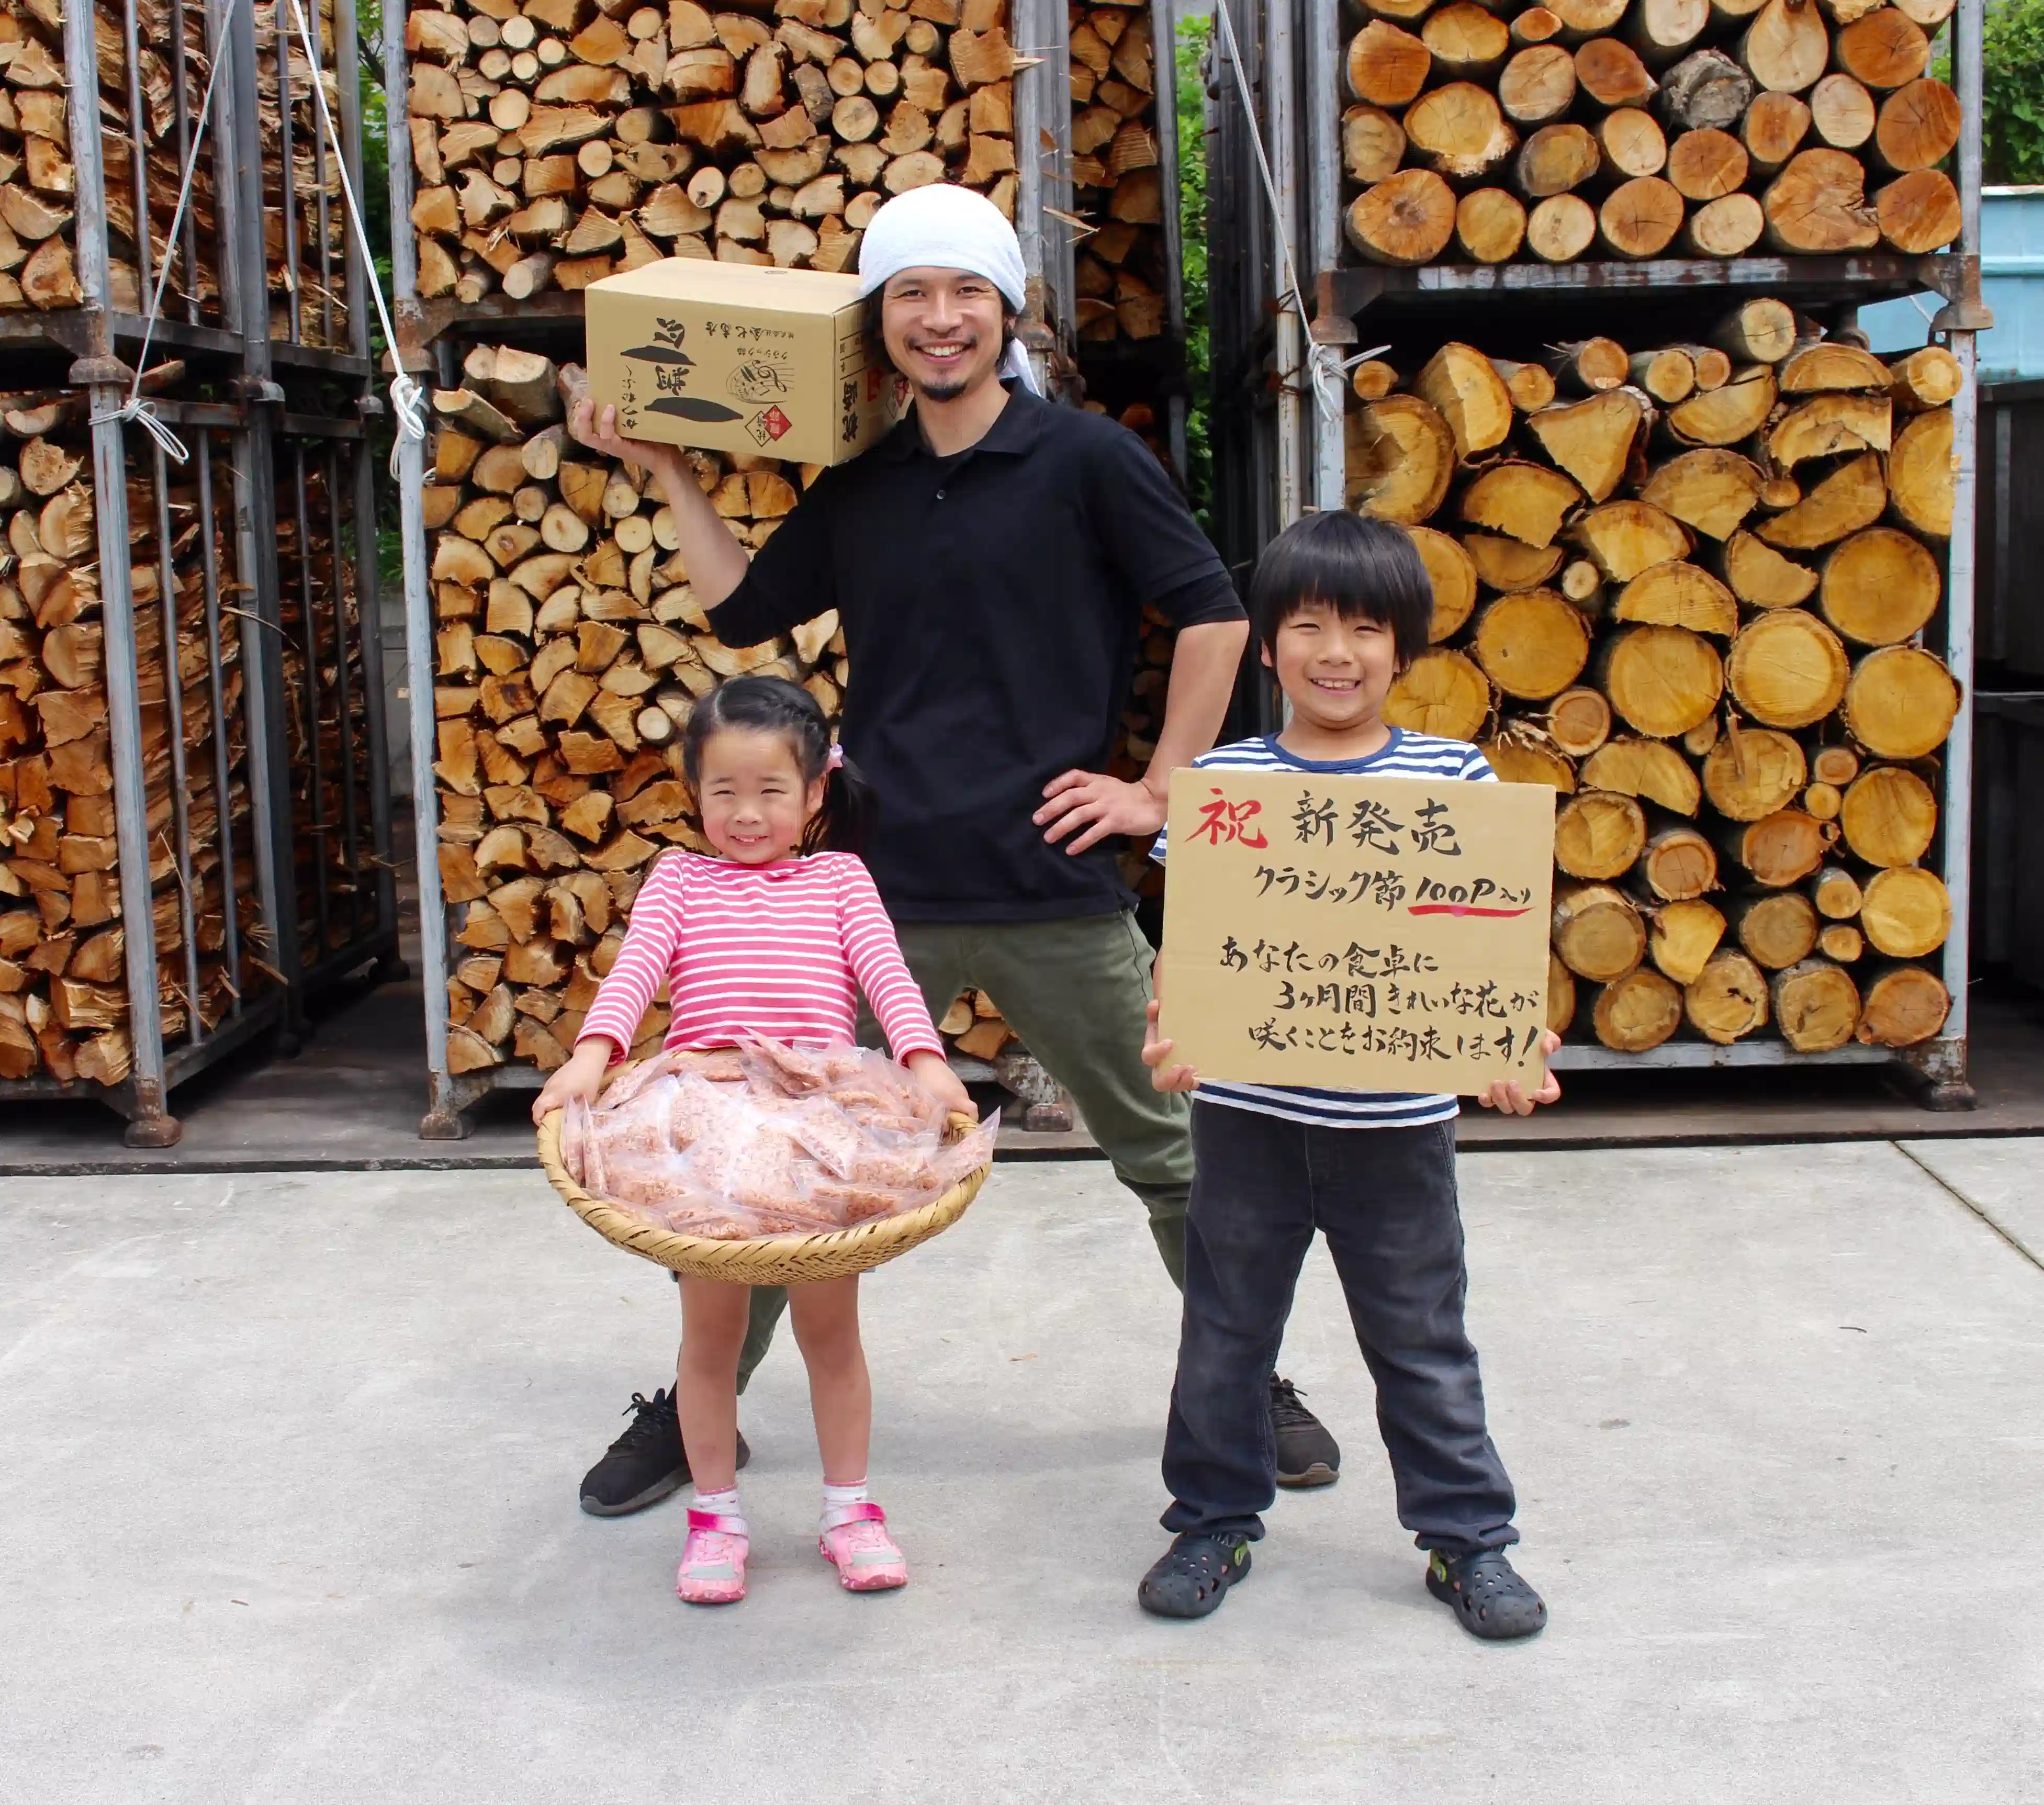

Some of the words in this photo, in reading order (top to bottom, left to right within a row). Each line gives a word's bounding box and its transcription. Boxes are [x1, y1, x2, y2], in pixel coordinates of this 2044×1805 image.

[1183, 788, 1269, 849] 祝
[1290, 790, 1462, 856] 新発売
[1219, 935, 1439, 979] あなたの食卓に
